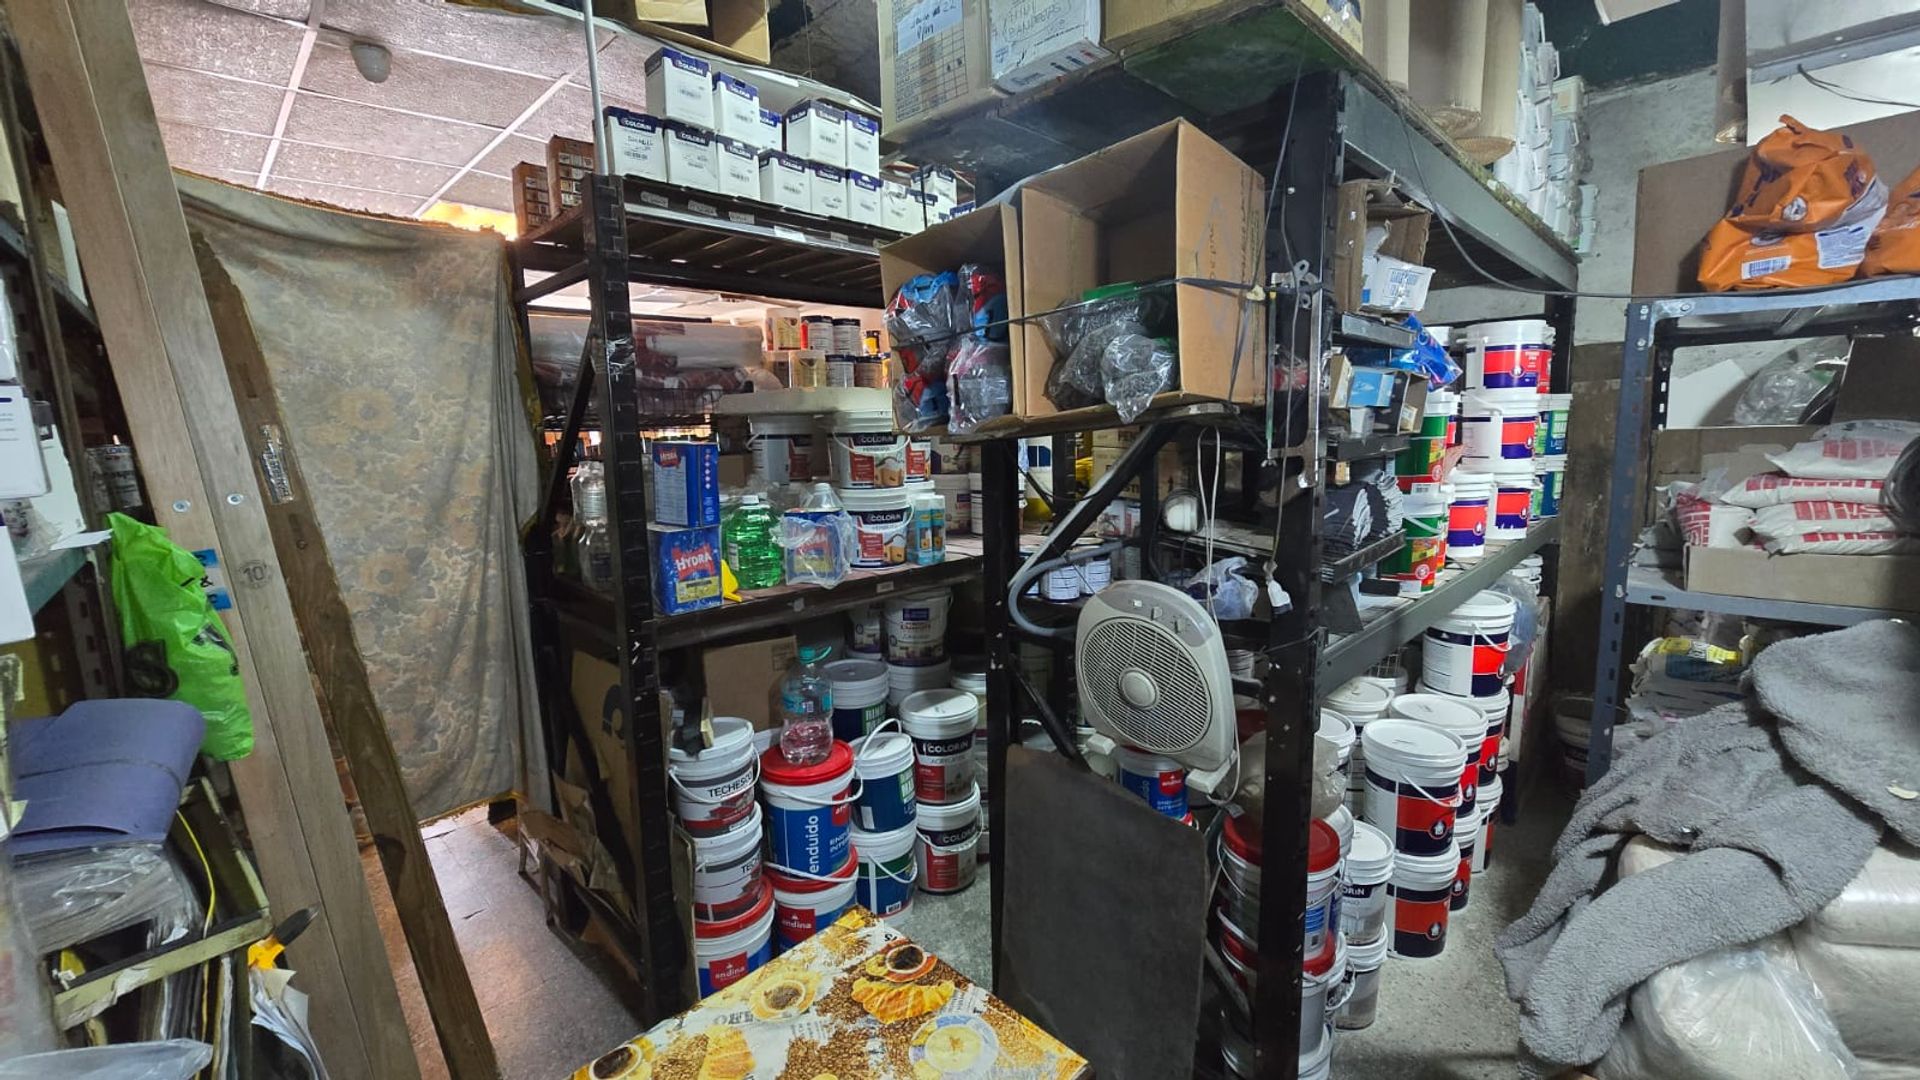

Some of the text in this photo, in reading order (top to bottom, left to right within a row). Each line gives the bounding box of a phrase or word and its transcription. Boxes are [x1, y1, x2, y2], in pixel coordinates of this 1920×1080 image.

[624, 117, 652, 131] COLORIN
[680, 131, 706, 145] COLORIN
[861, 434, 895, 444] COLORIN
[870, 513, 901, 522] COLORIN
[676, 551, 713, 572] HYDRA
[927, 740, 969, 754] COLORIN
[804, 815, 820, 874] enduido
[1342, 885, 1366, 896] ORIN
[781, 919, 813, 929] andina
[714, 966, 746, 980] andina
